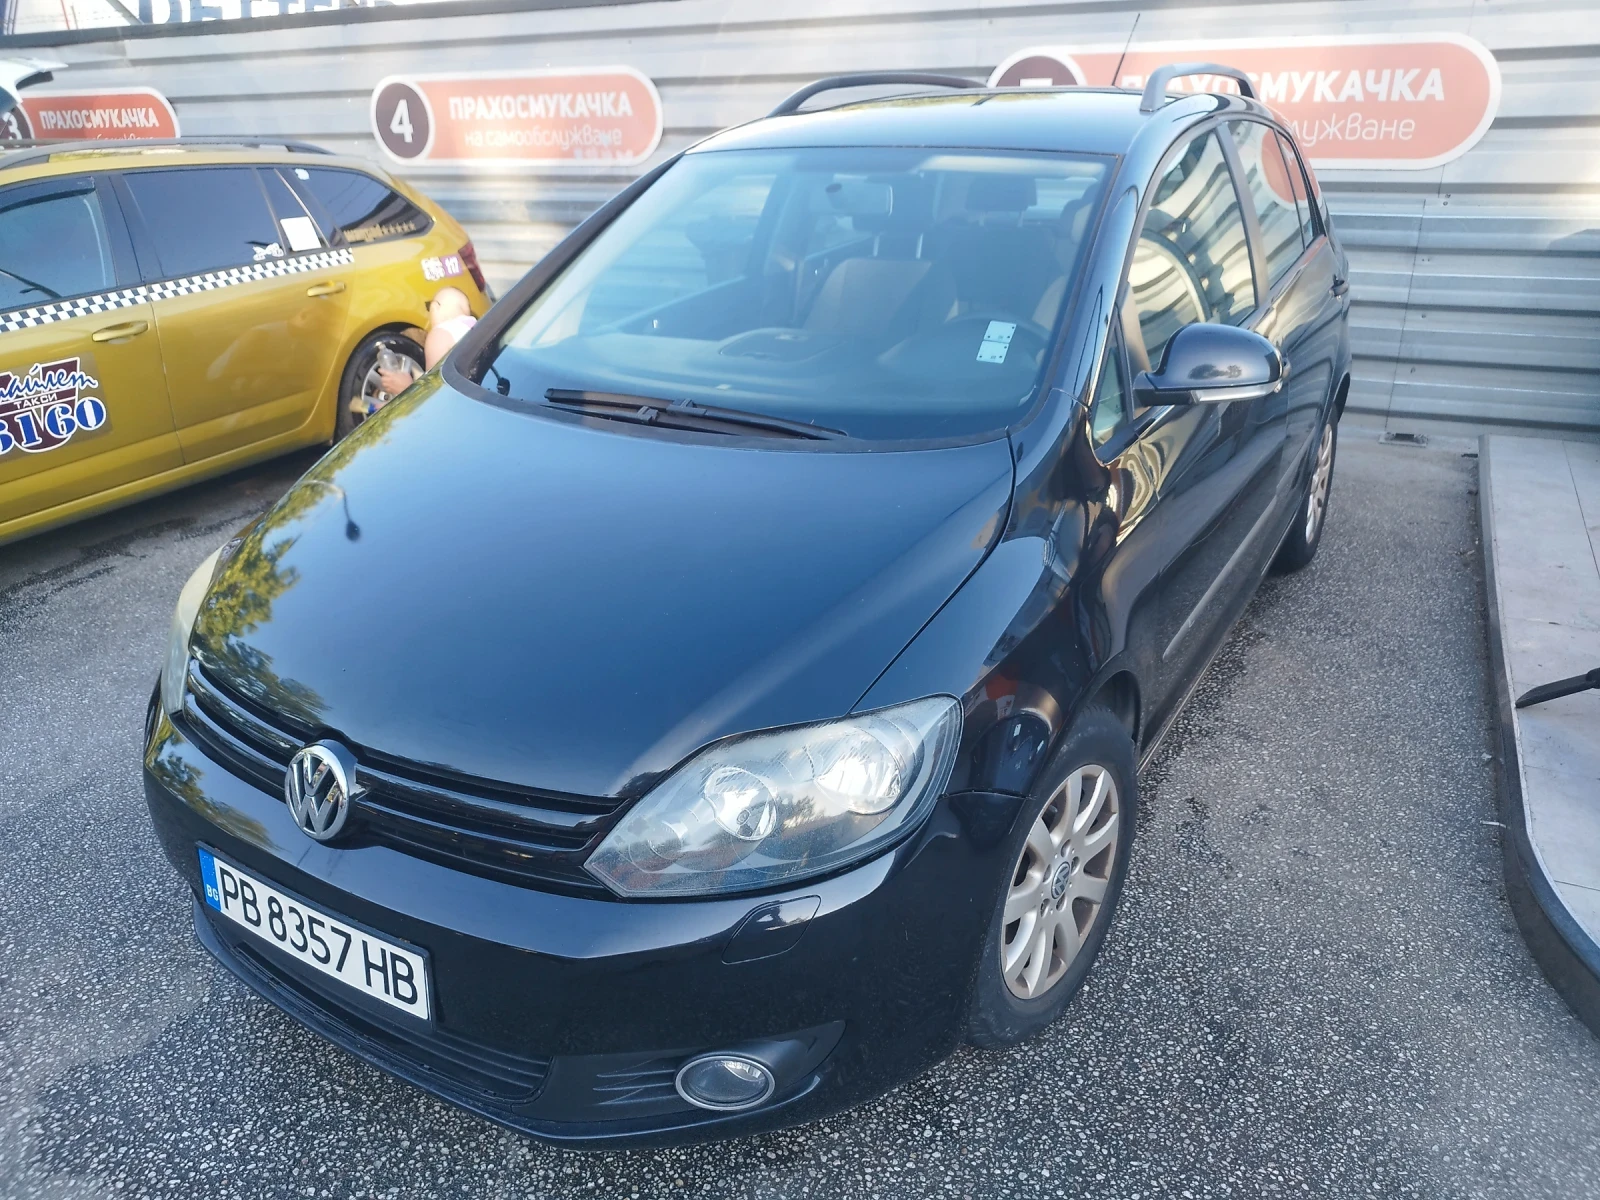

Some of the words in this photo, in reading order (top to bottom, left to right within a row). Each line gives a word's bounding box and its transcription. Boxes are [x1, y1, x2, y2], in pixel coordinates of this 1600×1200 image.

[39, 107, 160, 130] ПРАХОСМУКАЧКА
[449, 92, 633, 120] ПРАХОСМУКАЧКА
[3, 112, 22, 142] 3
[390, 99, 414, 143] 4
[465, 131, 485, 147] на
[486, 124, 622, 149] самообслужване
[14, 392, 58, 410] ТАКСИ
[206, 883, 219, 901] BG
[219, 866, 262, 928] PB
[267, 895, 353, 973] 8357
[361, 939, 419, 1006] HB
